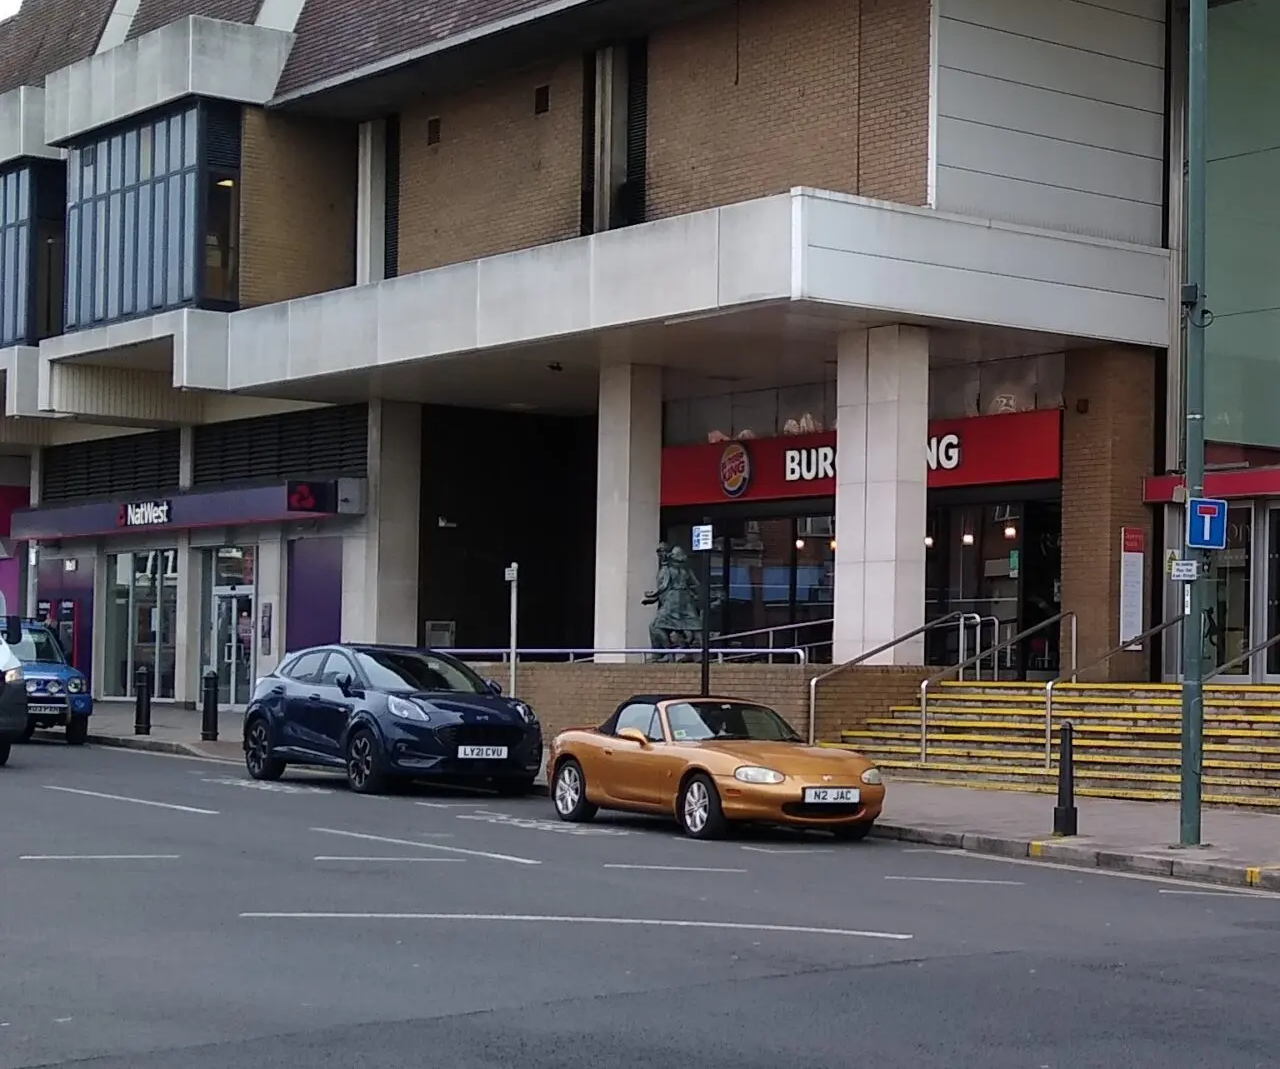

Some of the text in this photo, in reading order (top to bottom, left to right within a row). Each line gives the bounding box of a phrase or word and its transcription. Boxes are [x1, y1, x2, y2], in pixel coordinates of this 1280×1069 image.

[785, 434, 961, 481] BUR NG
[127, 501, 168, 525] NatWest
[463, 747, 503, 758] LY21 CVU
[813, 790, 851, 800] N2 JAC
